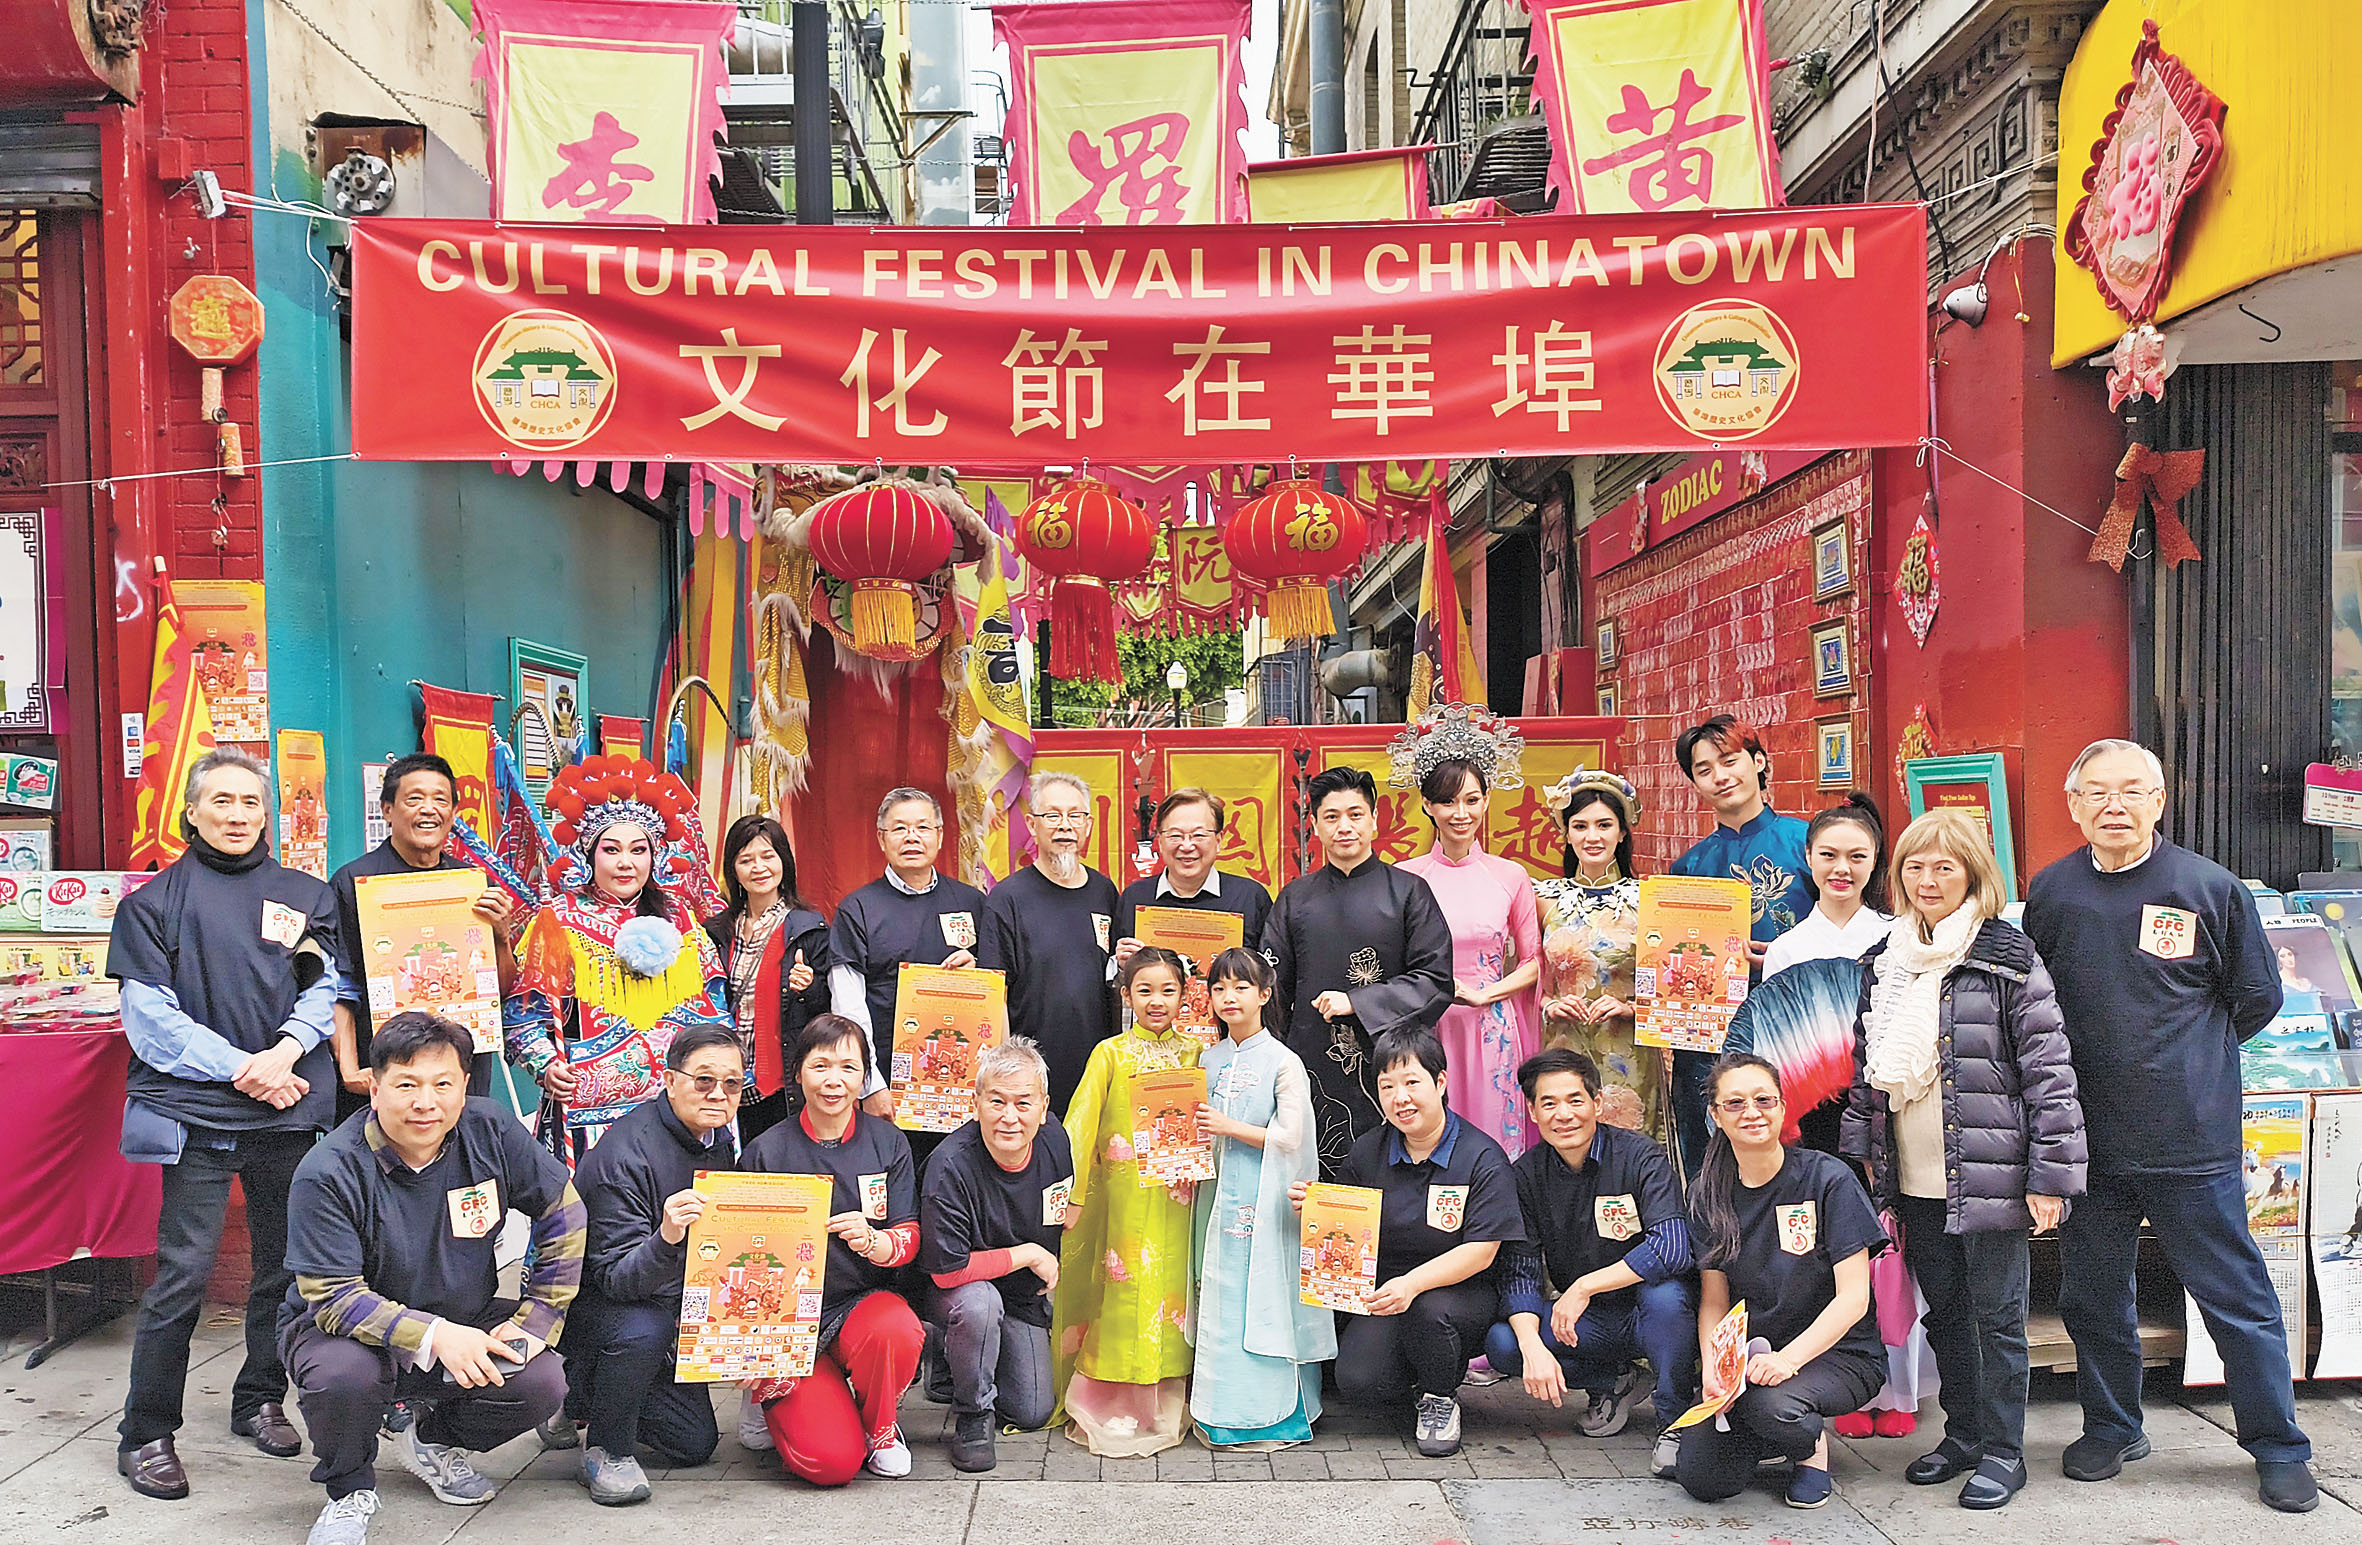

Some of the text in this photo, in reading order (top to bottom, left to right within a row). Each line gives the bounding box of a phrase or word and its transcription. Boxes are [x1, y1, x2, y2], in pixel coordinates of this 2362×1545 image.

[416, 226, 1857, 300] CULTURAL FESTIVAL IN CHINATOWN
[678, 321, 1604, 441] 文化節在華埠
[1711, 390, 1742, 399] CHCA
[530, 400, 561, 409] CHCA
[1660, 459, 1723, 525] ZODIAC
[1026, 501, 1072, 549] 福
[1284, 503, 1339, 552] 福
[55, 880, 81, 901] KitKat
[949, 921, 969, 929] CFC
[2153, 919, 2184, 932] CFC
[869, 1185, 885, 1196] CF
[1050, 1190, 1068, 1205] CFC
[461, 1195, 488, 1211] CFC
[1436, 1197, 1461, 1206] CFC
[1788, 1214, 1809, 1228] CC
